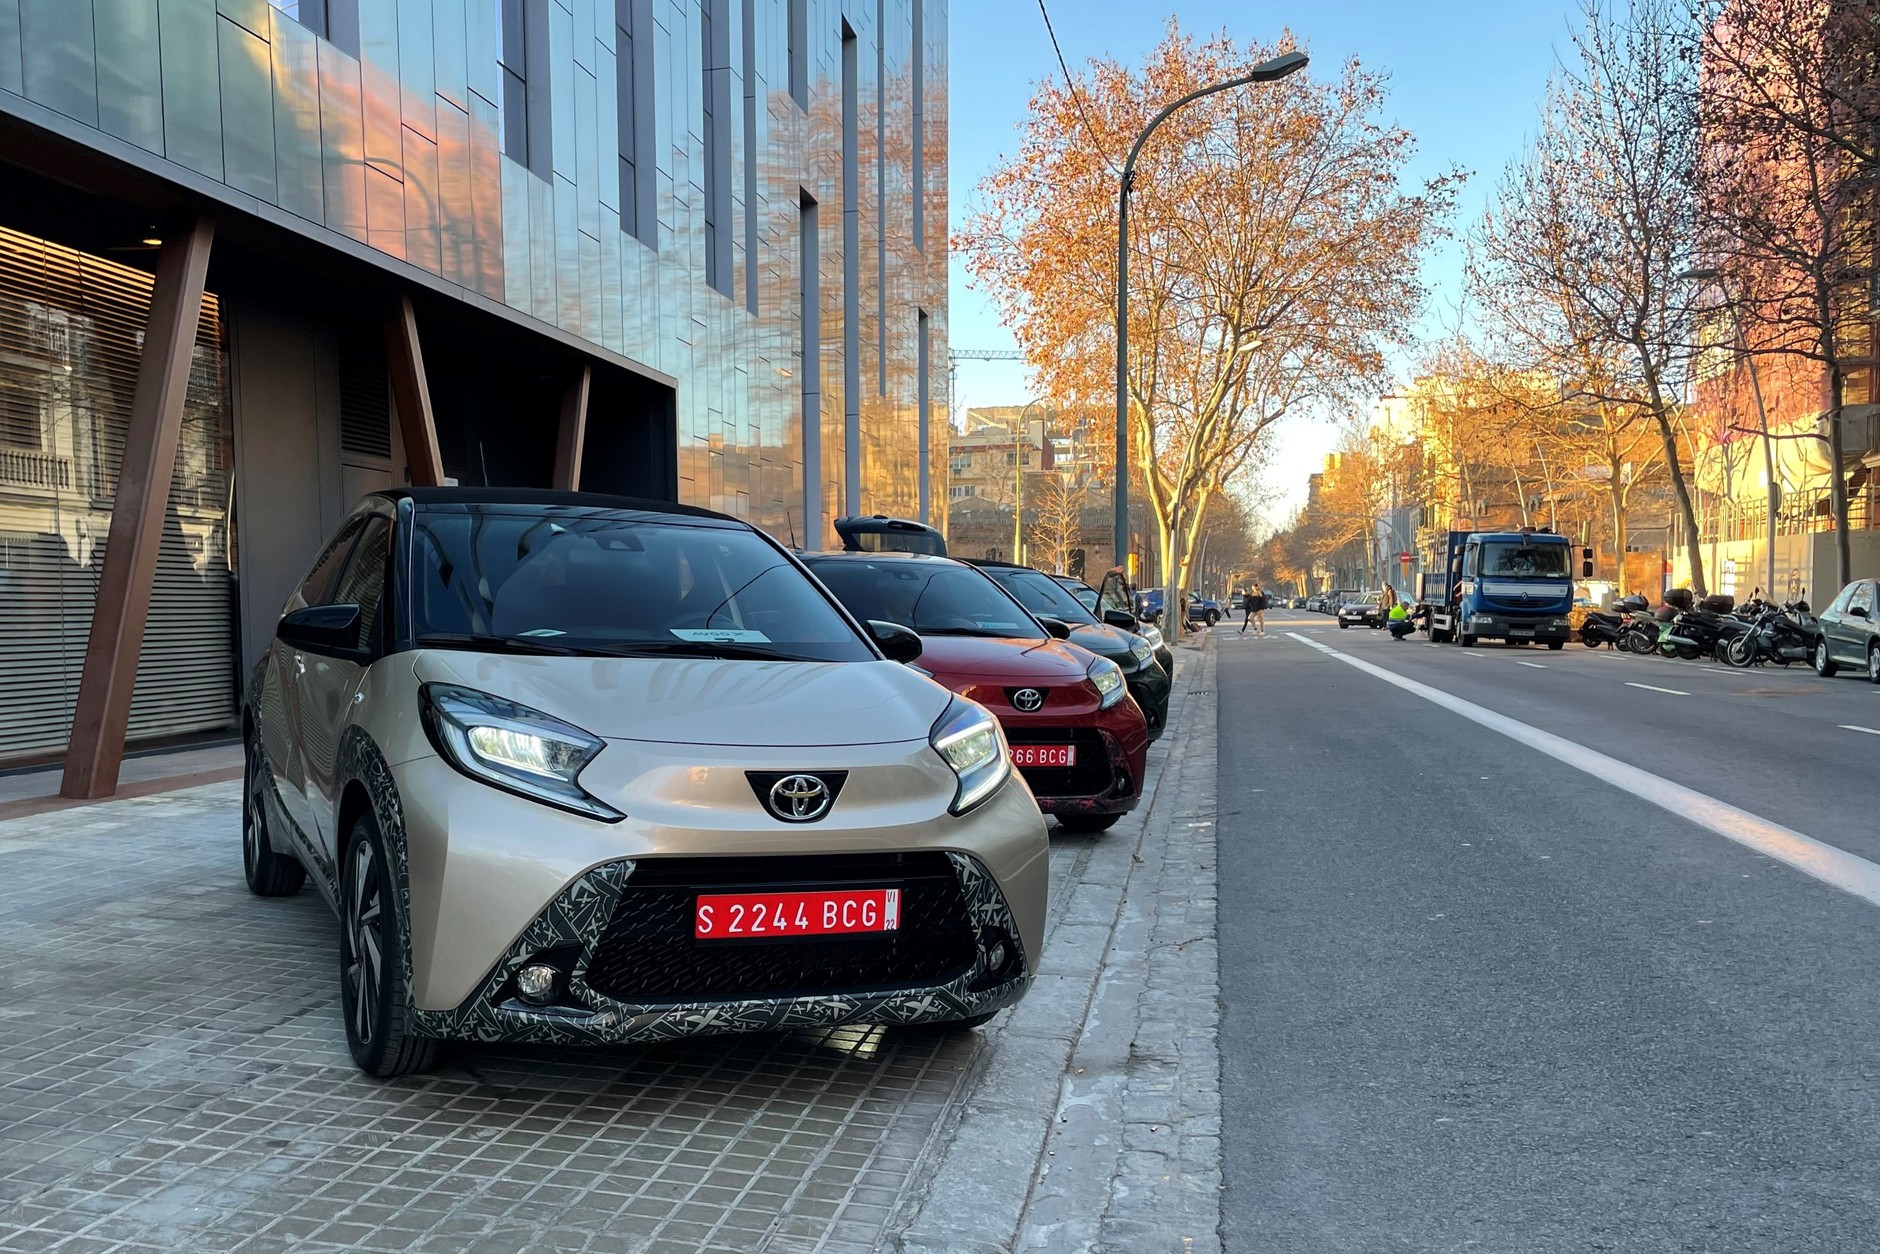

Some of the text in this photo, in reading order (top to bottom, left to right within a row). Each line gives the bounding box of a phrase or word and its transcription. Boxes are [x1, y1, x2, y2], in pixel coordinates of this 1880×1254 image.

[1039, 749, 1066, 764] BCG
[887, 890, 896, 903] VI
[698, 899, 877, 934] S 2244 BCG
[885, 918, 895, 931] 22
